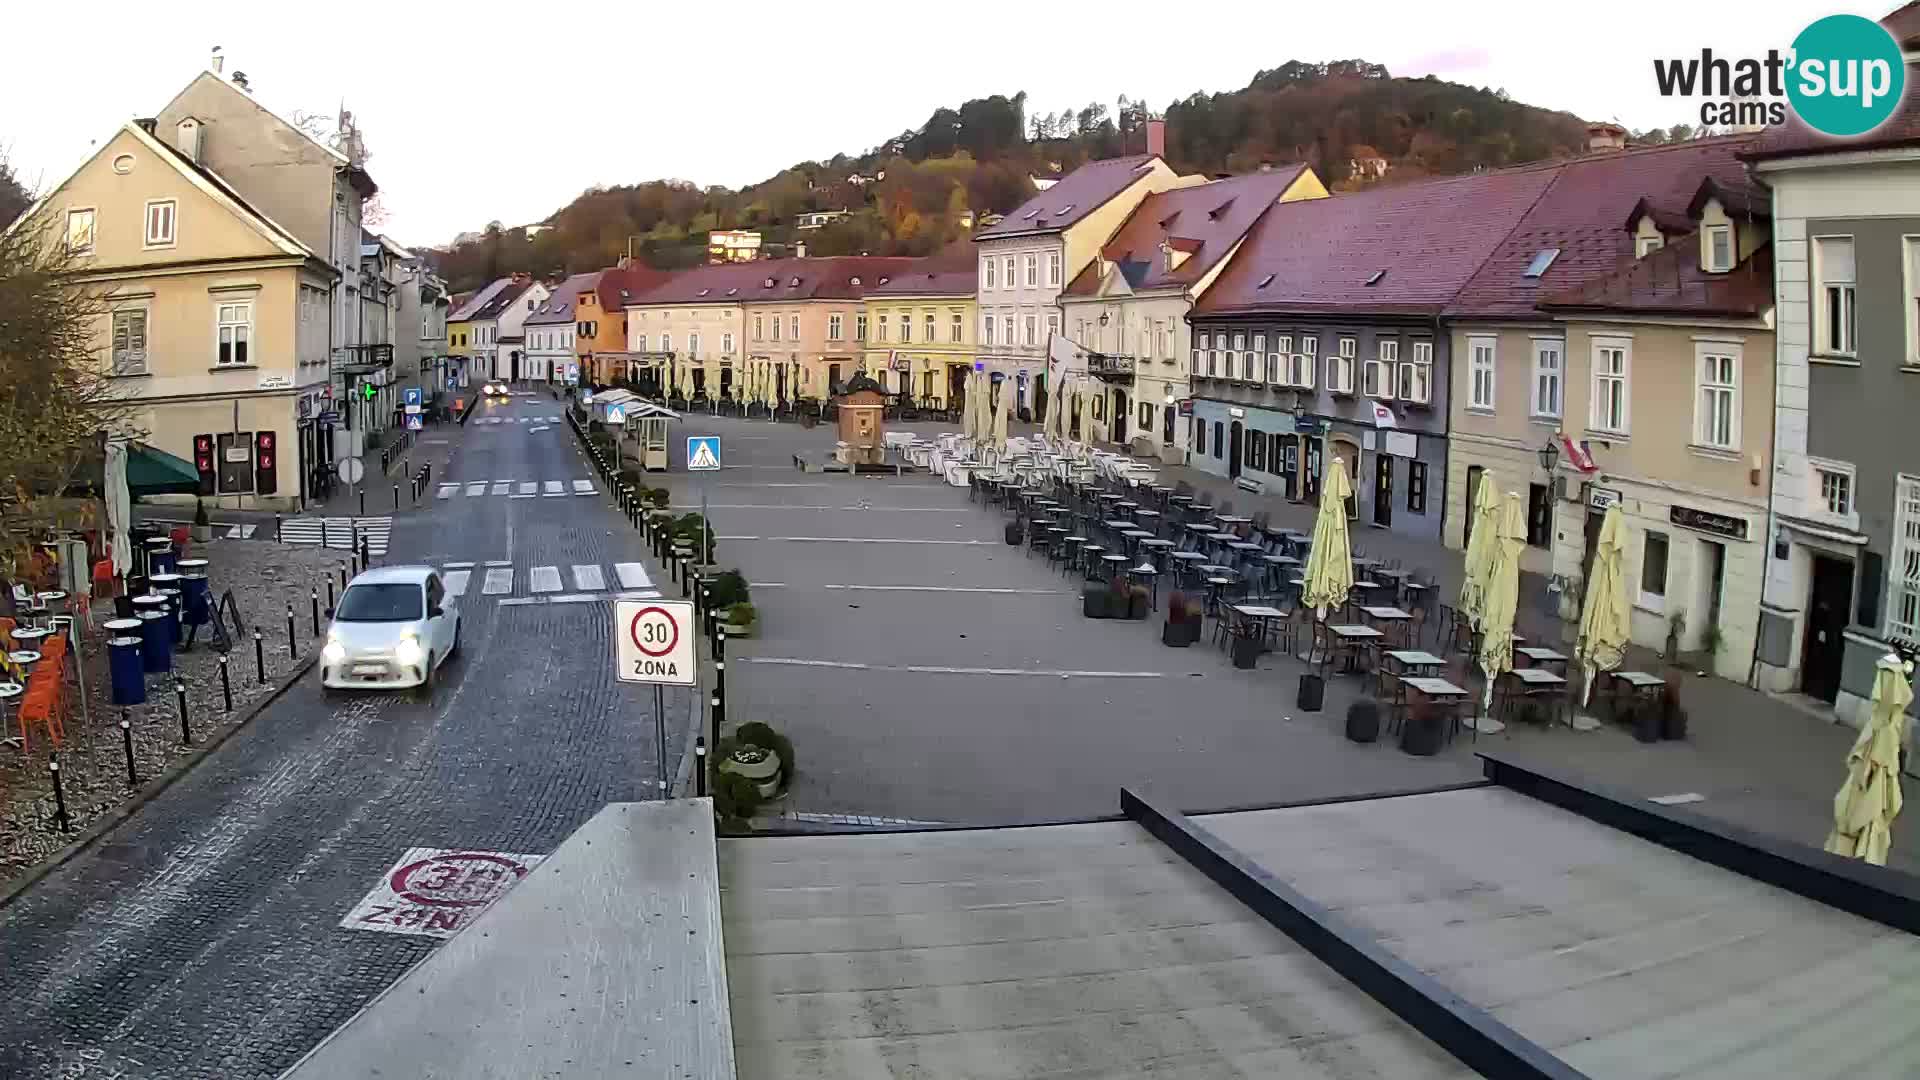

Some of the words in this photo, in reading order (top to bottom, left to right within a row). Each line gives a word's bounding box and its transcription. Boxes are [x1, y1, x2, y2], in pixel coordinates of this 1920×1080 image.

[409, 391, 417, 404] P
[643, 623, 667, 643] 30
[634, 660, 678, 676] ZONA
